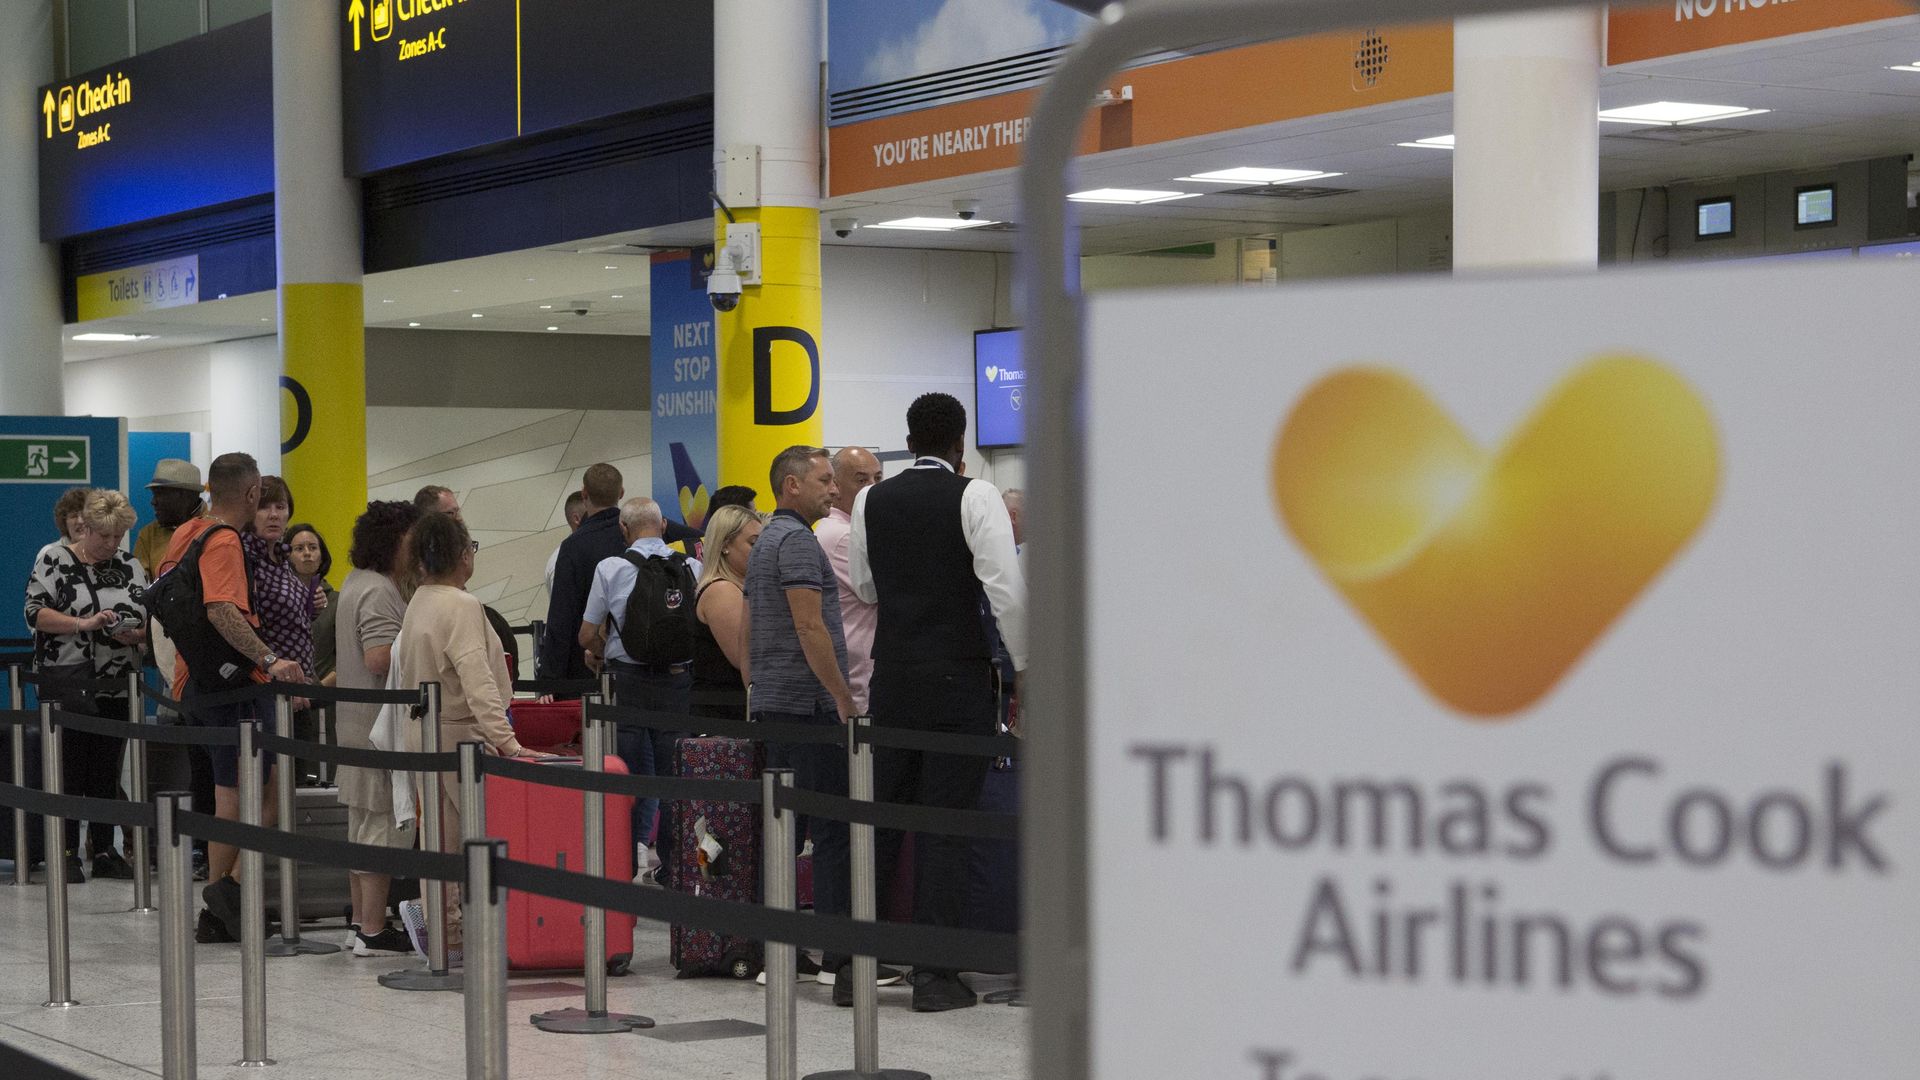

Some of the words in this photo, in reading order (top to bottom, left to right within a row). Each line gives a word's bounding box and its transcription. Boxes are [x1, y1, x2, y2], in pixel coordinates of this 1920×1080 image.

[398, 38, 427, 61] Zones
[427, 27, 447, 53] A-C
[77, 72, 131, 117] Check-in
[77, 130, 98, 149] Zones
[97, 123, 111, 144] A-C
[873, 136, 929, 168] YOU'RE
[932, 123, 991, 157] NEARLY
[108, 277, 139, 302] Toilets
[673, 321, 711, 348] NEXT
[674, 356, 711, 382] STOP
[753, 325, 820, 426] D
[1126, 740, 1554, 861] Thomas
[1582, 752, 1894, 875] Cook
[1289, 873, 1708, 1000] Airlines
